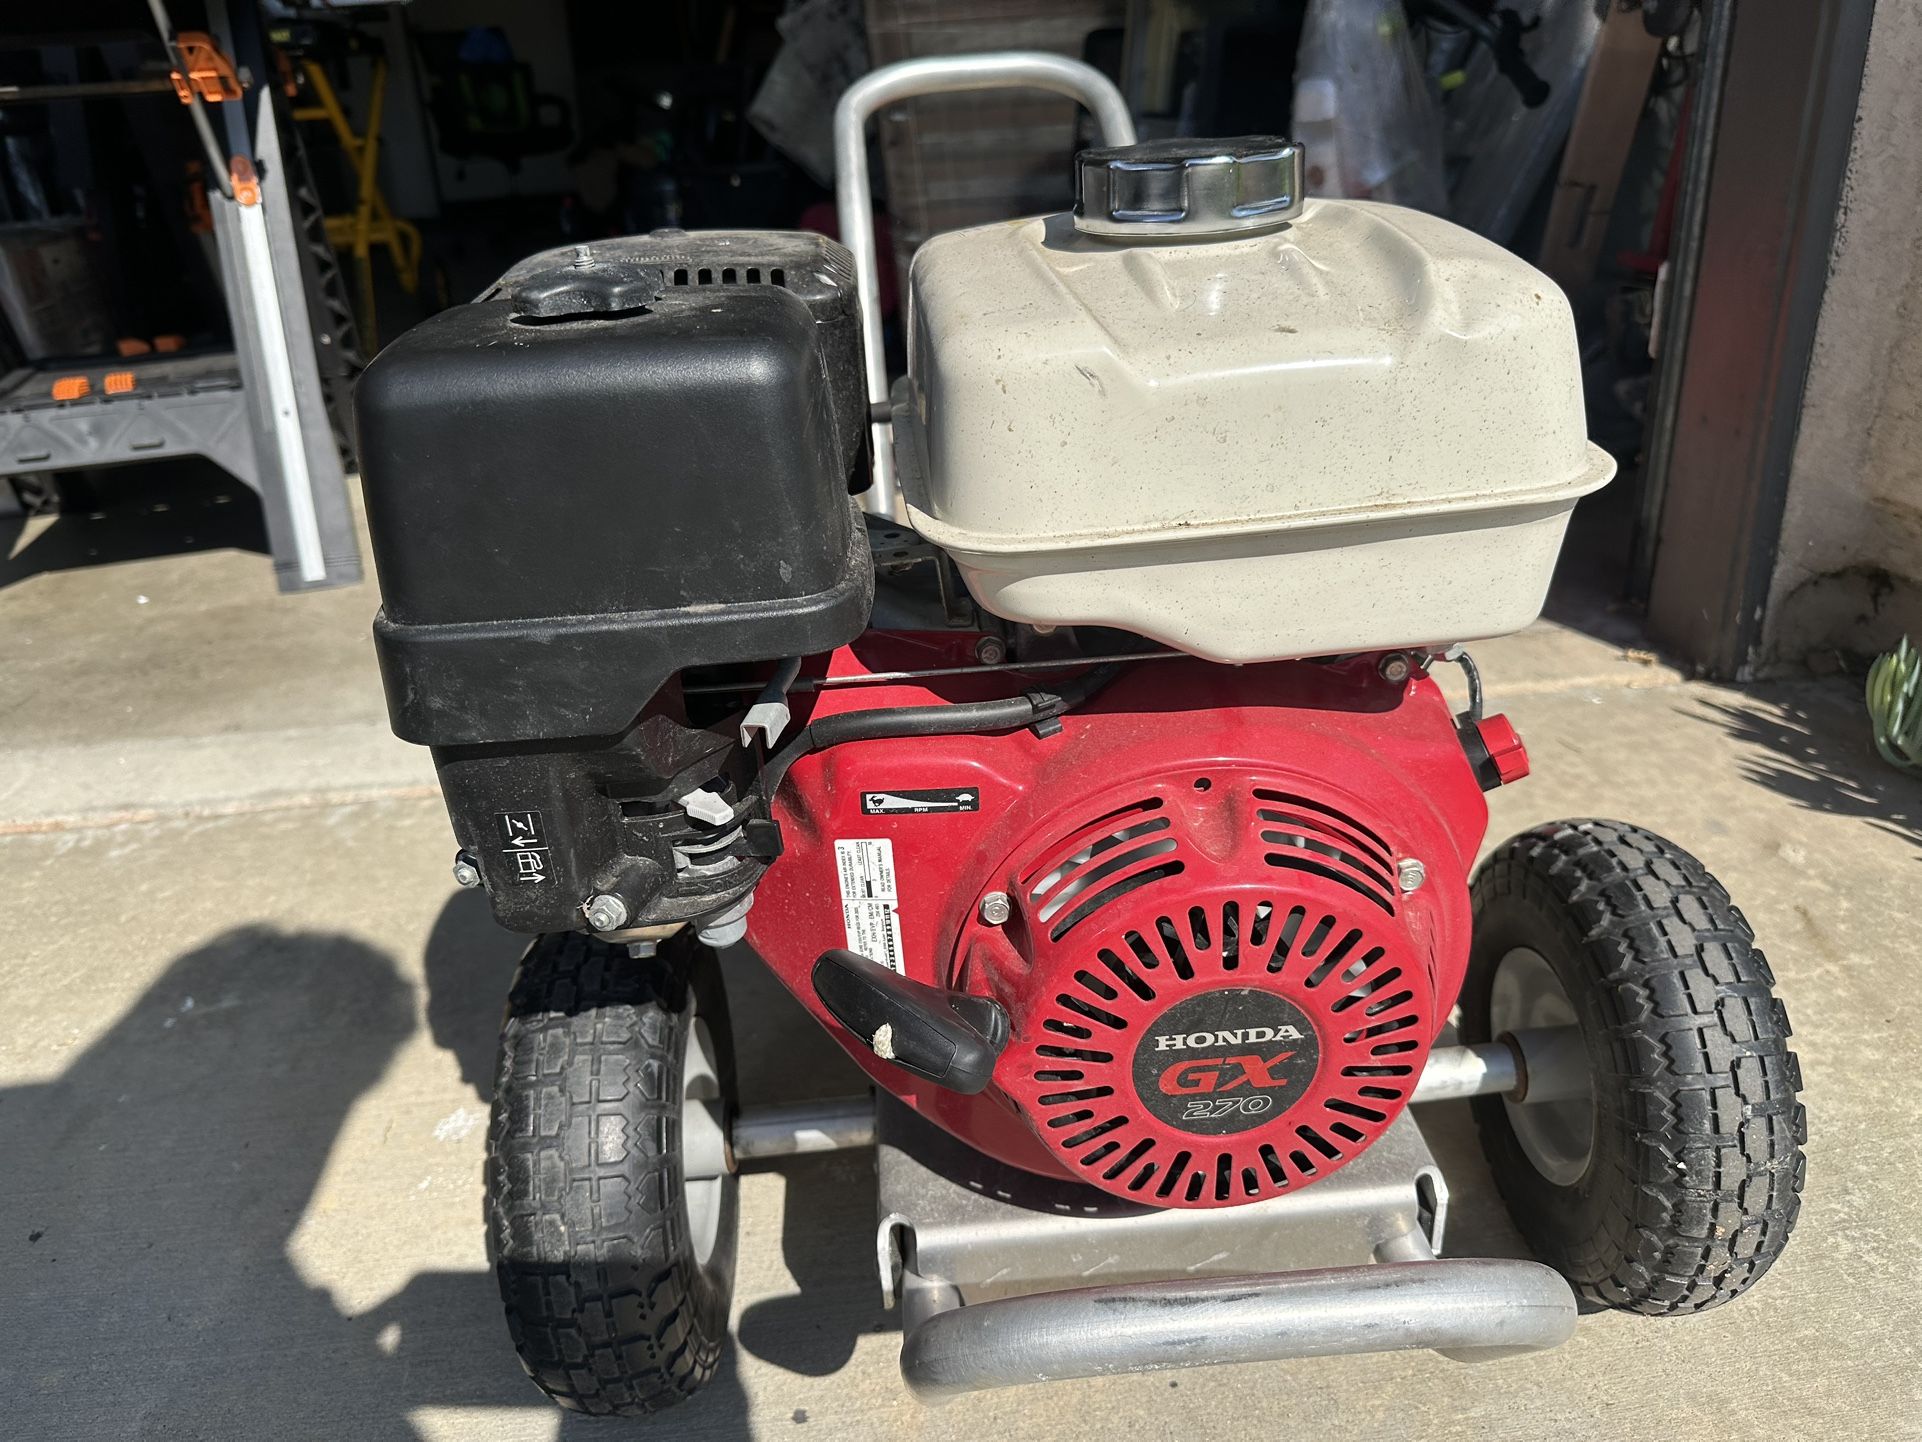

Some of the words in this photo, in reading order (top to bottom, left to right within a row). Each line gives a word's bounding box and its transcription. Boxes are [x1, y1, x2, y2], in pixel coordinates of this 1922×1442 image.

[1155, 1025, 1305, 1052] HONDA
[1158, 1051, 1298, 1096] GX
[1183, 1095, 1273, 1120] 270
